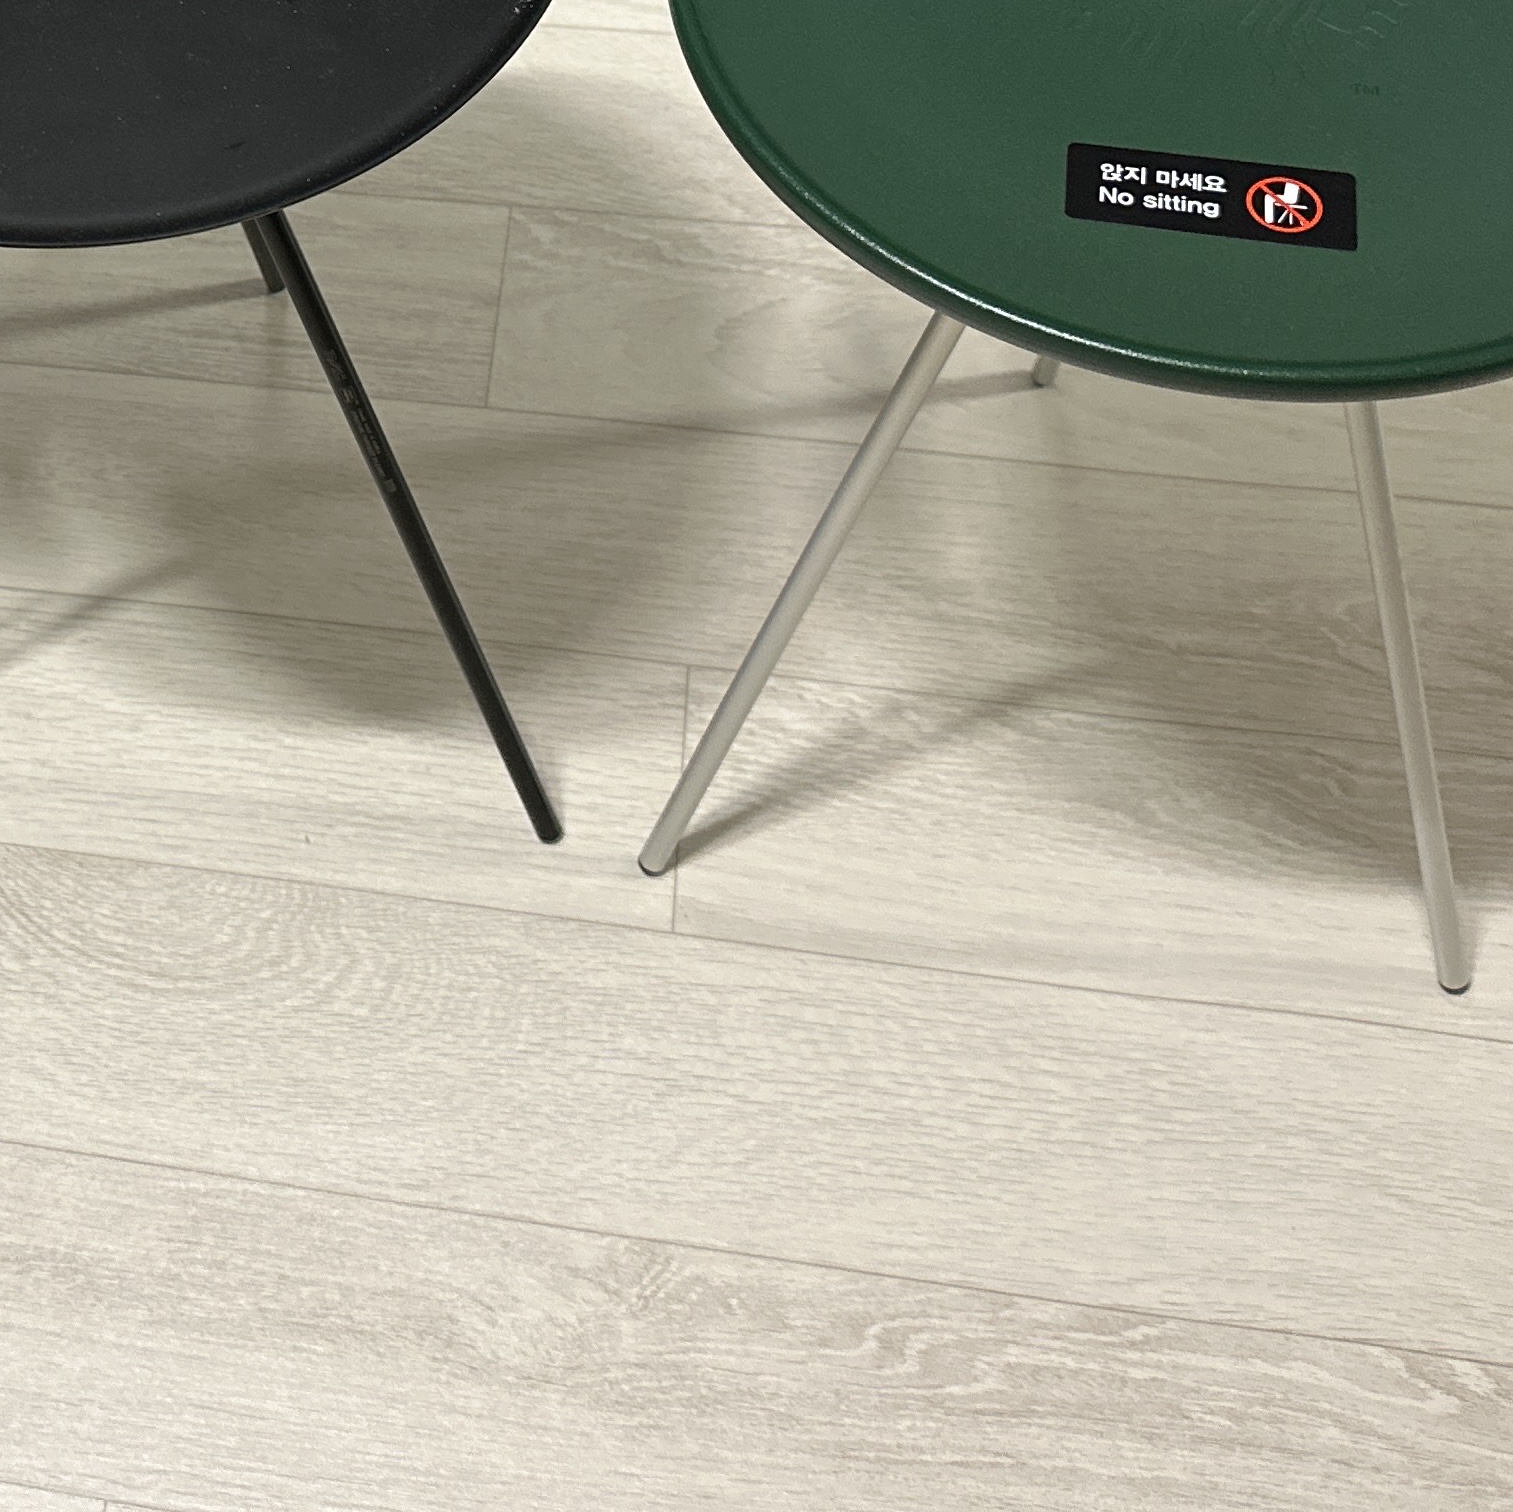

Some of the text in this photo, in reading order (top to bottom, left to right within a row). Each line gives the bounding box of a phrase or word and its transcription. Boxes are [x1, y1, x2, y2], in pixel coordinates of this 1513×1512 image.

[1155, 170, 1228, 193] 마세요
[1098, 185, 1221, 219] No sitting
